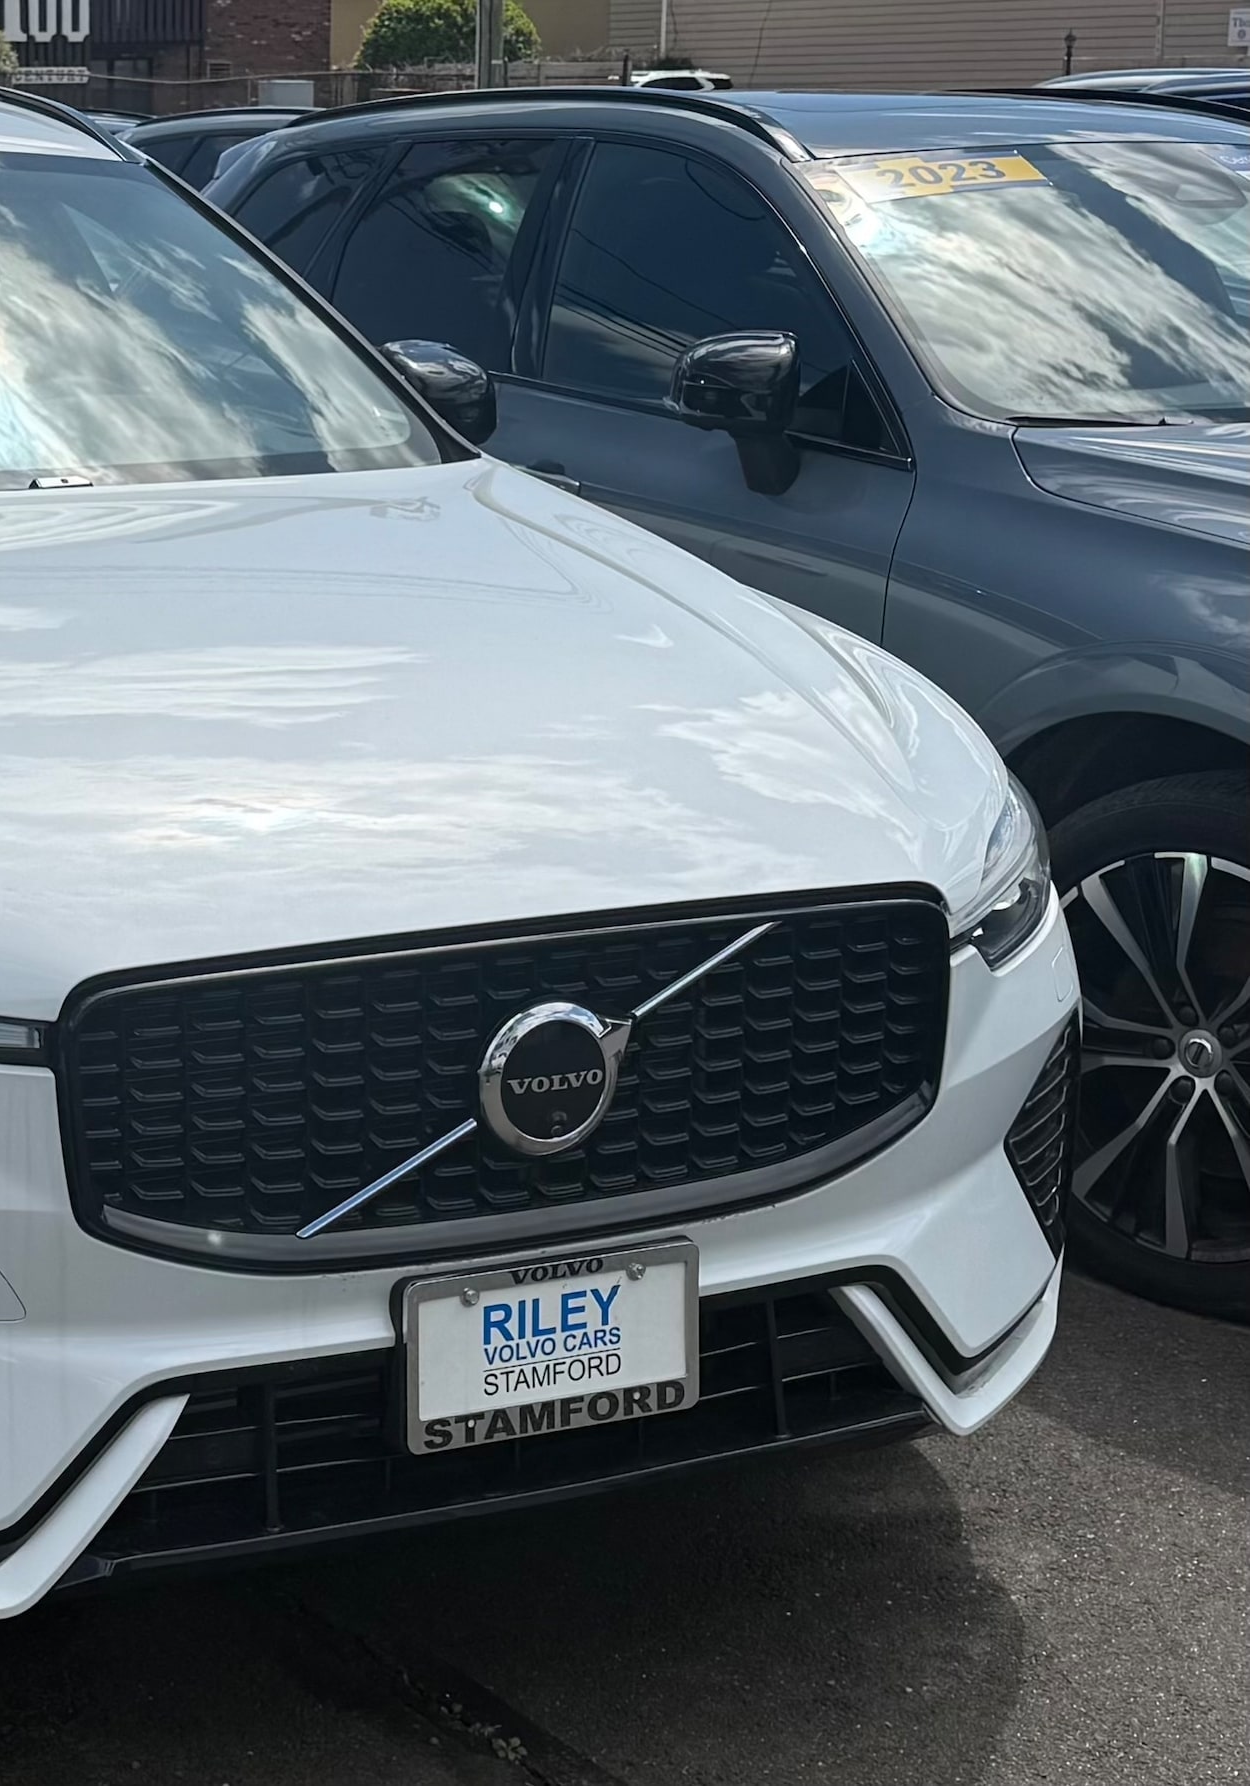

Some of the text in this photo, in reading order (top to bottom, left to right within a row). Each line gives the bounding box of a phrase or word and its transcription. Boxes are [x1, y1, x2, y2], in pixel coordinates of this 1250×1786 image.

[2, 0, 90, 42] 100
[877, 160, 1006, 189] 2023
[507, 1069, 604, 1095] VOLVO
[510, 1258, 603, 1285] VOLVO
[483, 1284, 621, 1346] RILEY
[484, 1326, 621, 1365] VOLVO CARS
[484, 1352, 621, 1396] STAMFORD
[424, 1380, 686, 1450] STAMFORD
